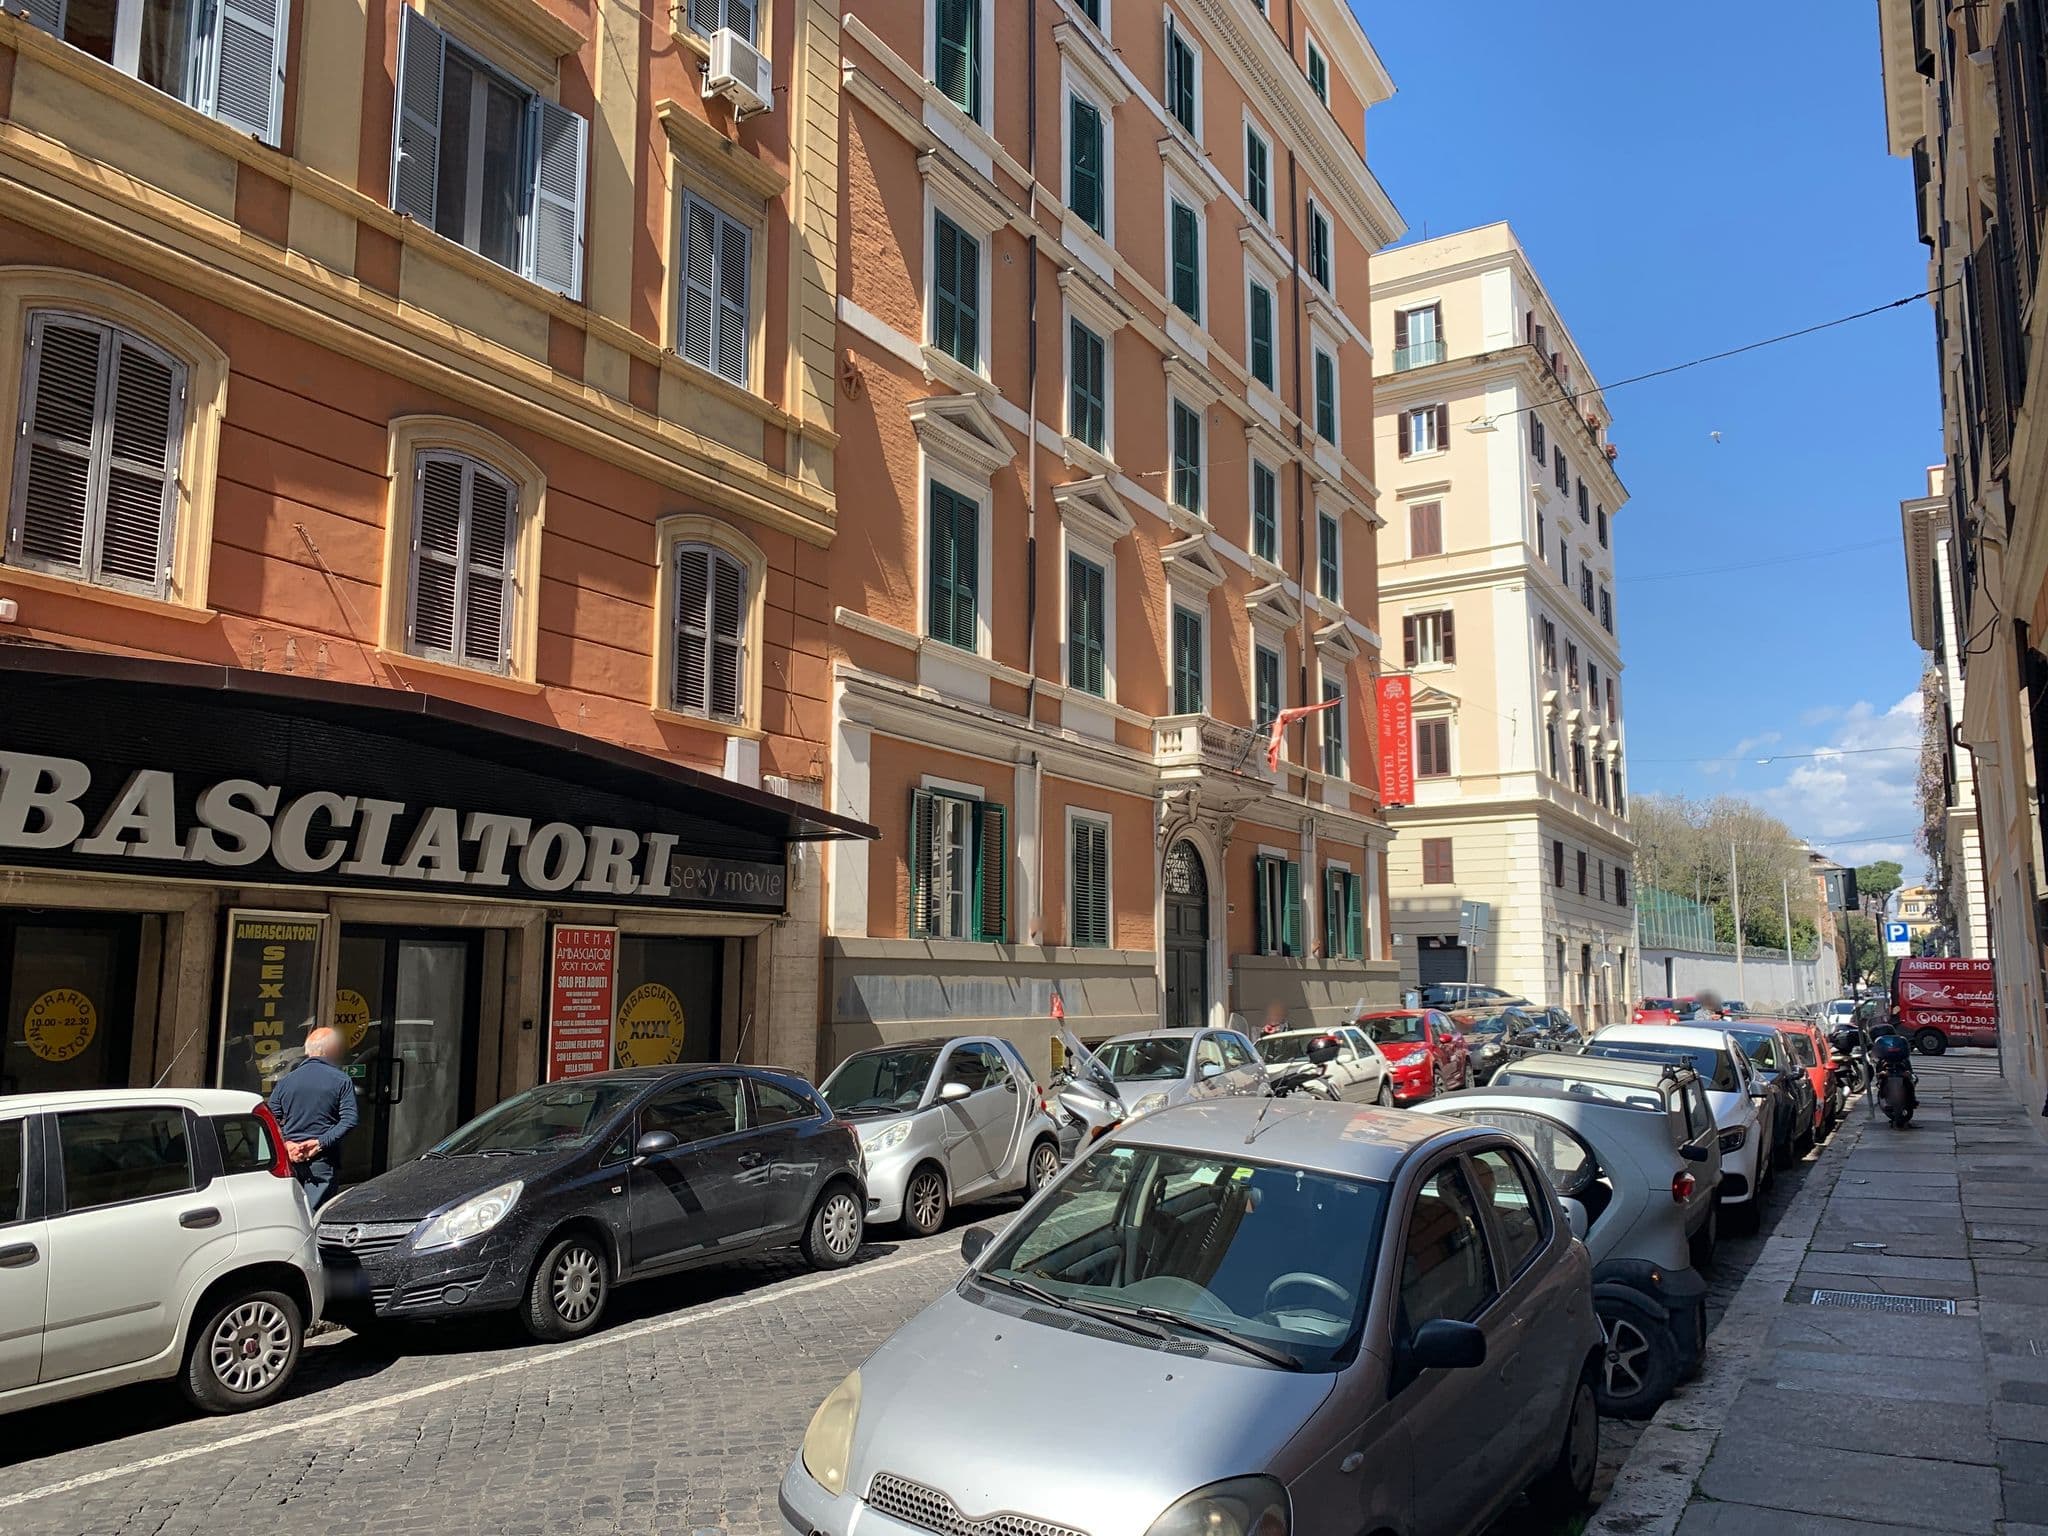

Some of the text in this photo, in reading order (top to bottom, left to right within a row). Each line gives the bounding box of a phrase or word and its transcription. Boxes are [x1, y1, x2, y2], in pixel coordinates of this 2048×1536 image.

[1396, 702, 1409, 795] MONTECARLO
[1384, 752, 1395, 796] HOTEL
[671, 864, 780, 896] sexy movie
[237, 923, 317, 941] AMBASCIATORI
[557, 931, 611, 945] CINEMA
[1890, 925, 1904, 941] P
[557, 947, 611, 960] AMBASCIATORI
[561, 962, 606, 971] SEXY MOVIE
[1909, 962, 1992, 971] ARREDI PER HO
[557, 976, 608, 988] SOLO PER ADULTI
[34, 991, 89, 1015] ORARIO
[337, 991, 360, 1006] ILM
[620, 986, 683, 1028] AMBASCIATORI
[31, 1018, 56, 1027] 10.00
[64, 1017, 89, 1026] 22.30
[29, 1026, 89, 1058] NON-STOP
